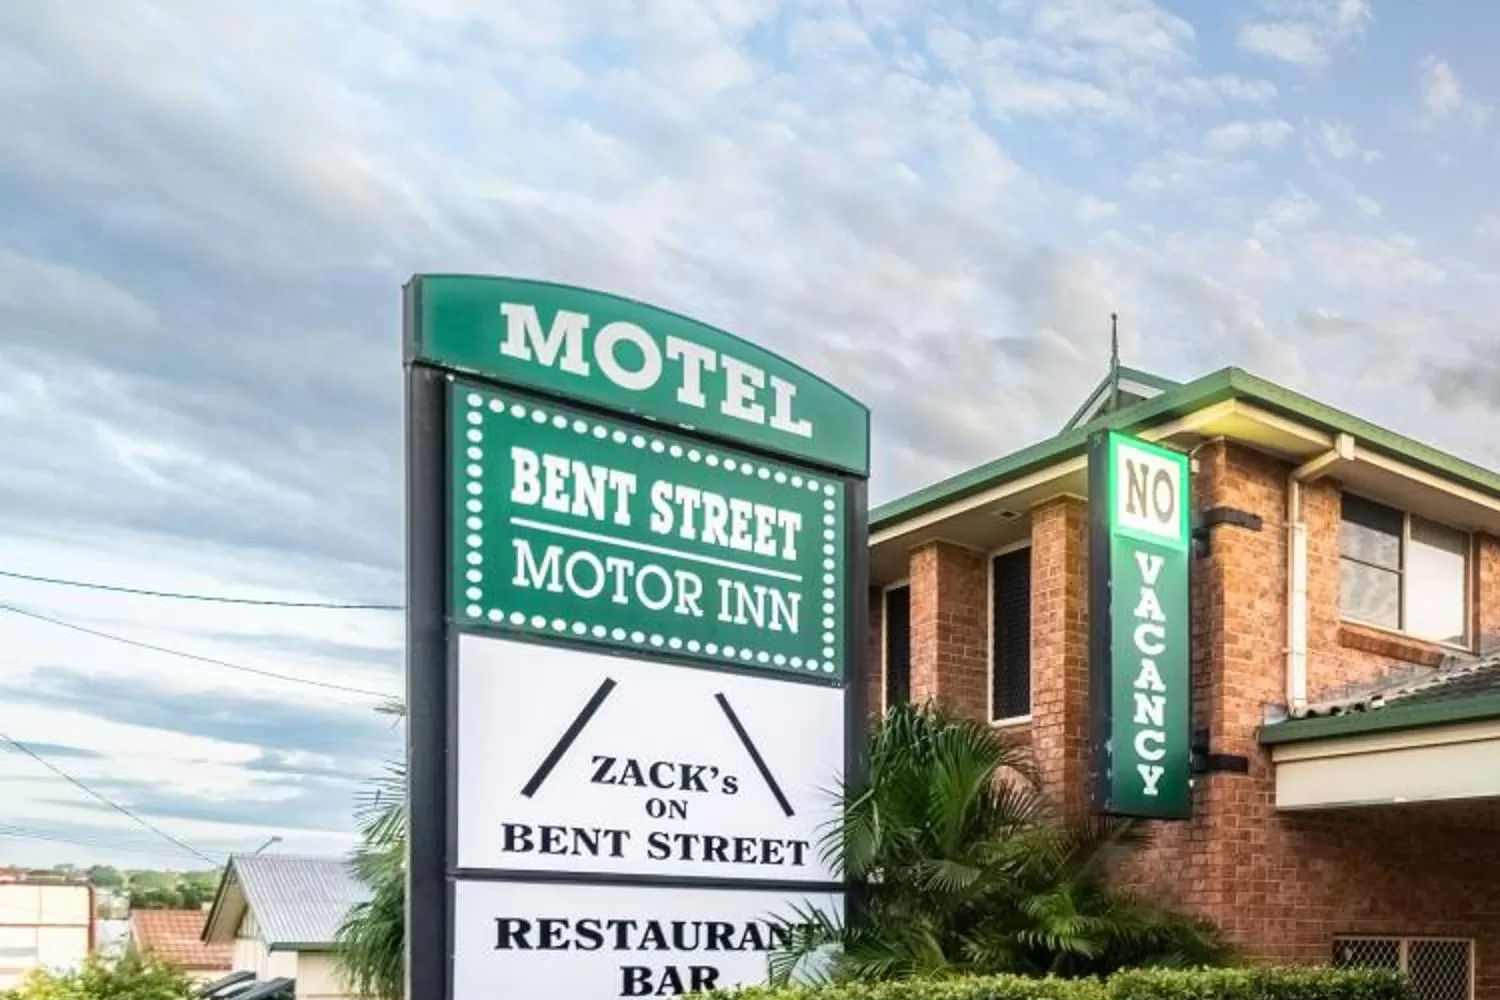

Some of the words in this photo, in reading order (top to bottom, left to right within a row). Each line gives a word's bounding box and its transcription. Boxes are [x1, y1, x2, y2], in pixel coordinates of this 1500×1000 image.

[500, 302, 812, 439] MOTEL
[510, 446, 636, 527] BENT
[650, 480, 803, 561] STREET
[1125, 458, 1175, 524] NO
[512, 539, 704, 618] MOTOR
[717, 579, 802, 634] INN
[1134, 551, 1167, 796] VACANCY
[590, 755, 739, 796] ZACK's
[645, 797, 688, 820] ON
[501, 823, 630, 858] BENT
[647, 831, 809, 867] STREET
[620, 965, 720, 997] BAR
